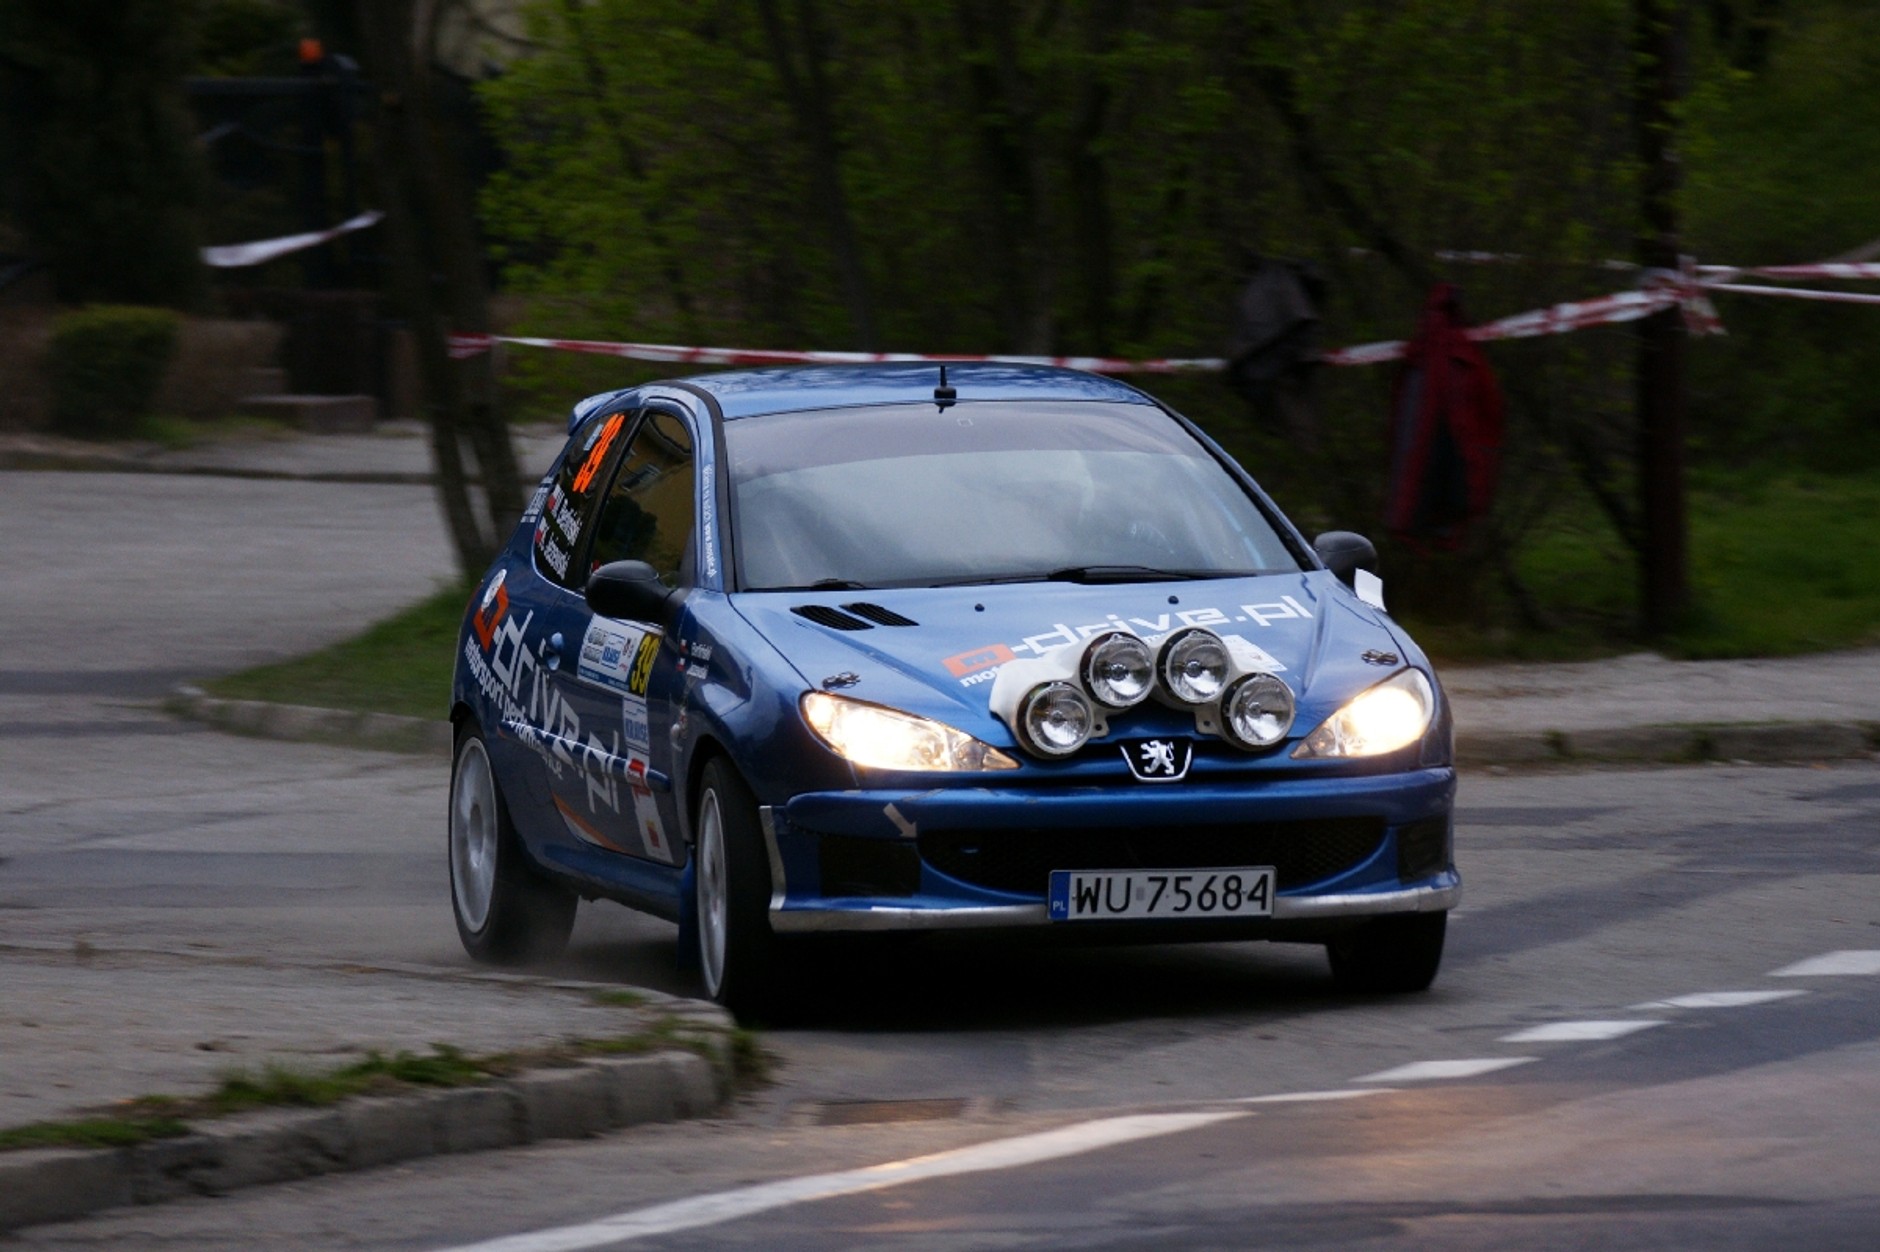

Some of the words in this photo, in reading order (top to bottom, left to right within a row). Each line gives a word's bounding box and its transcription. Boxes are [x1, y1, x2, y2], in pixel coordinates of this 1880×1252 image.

[629, 633, 662, 695] 39
[1052, 900, 1067, 912] PL
[1075, 876, 1132, 914] WU
[1147, 873, 1270, 914] 75684
